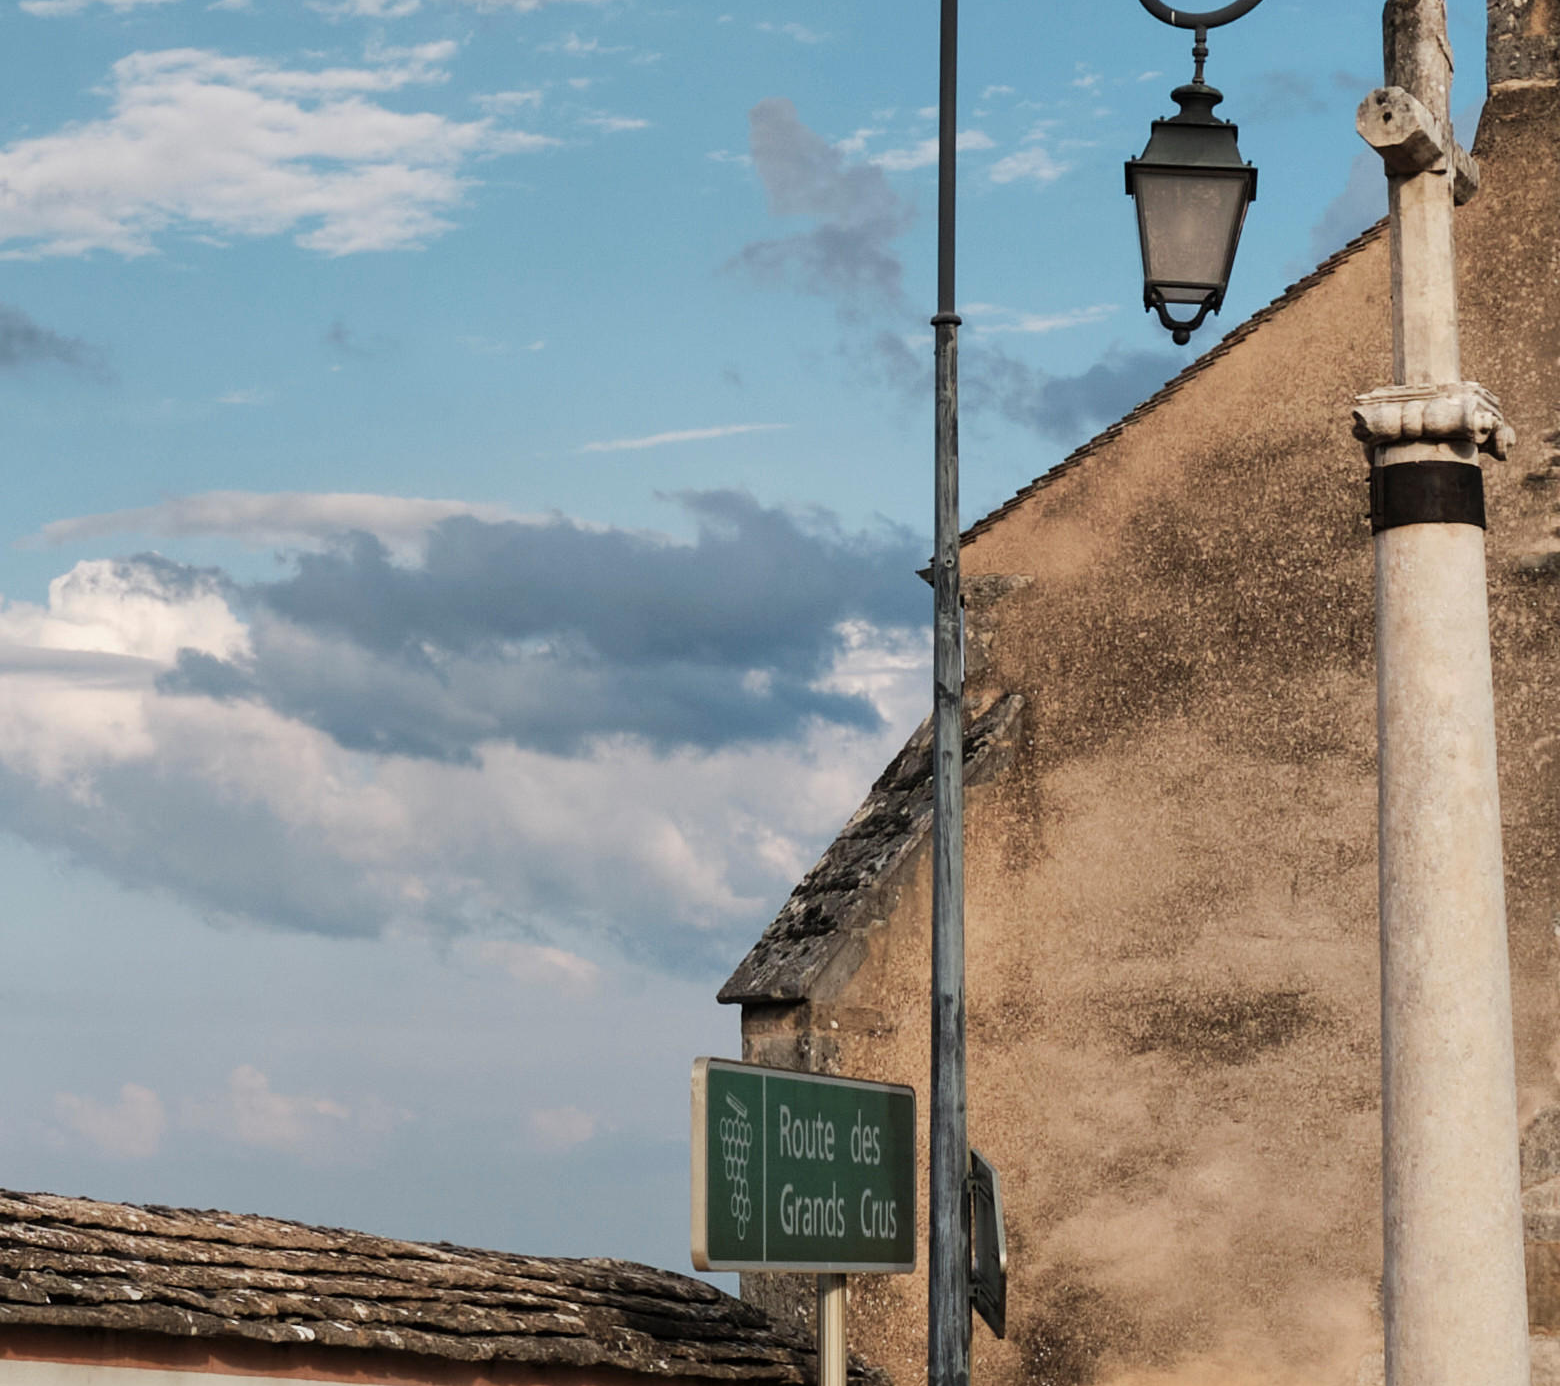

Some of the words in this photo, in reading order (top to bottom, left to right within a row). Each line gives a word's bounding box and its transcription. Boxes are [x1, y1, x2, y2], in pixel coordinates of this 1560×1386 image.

[779, 1104, 835, 1163] Route
[850, 1109, 881, 1165] des
[780, 1182, 846, 1239] Grands
[860, 1188, 898, 1240] Crus
